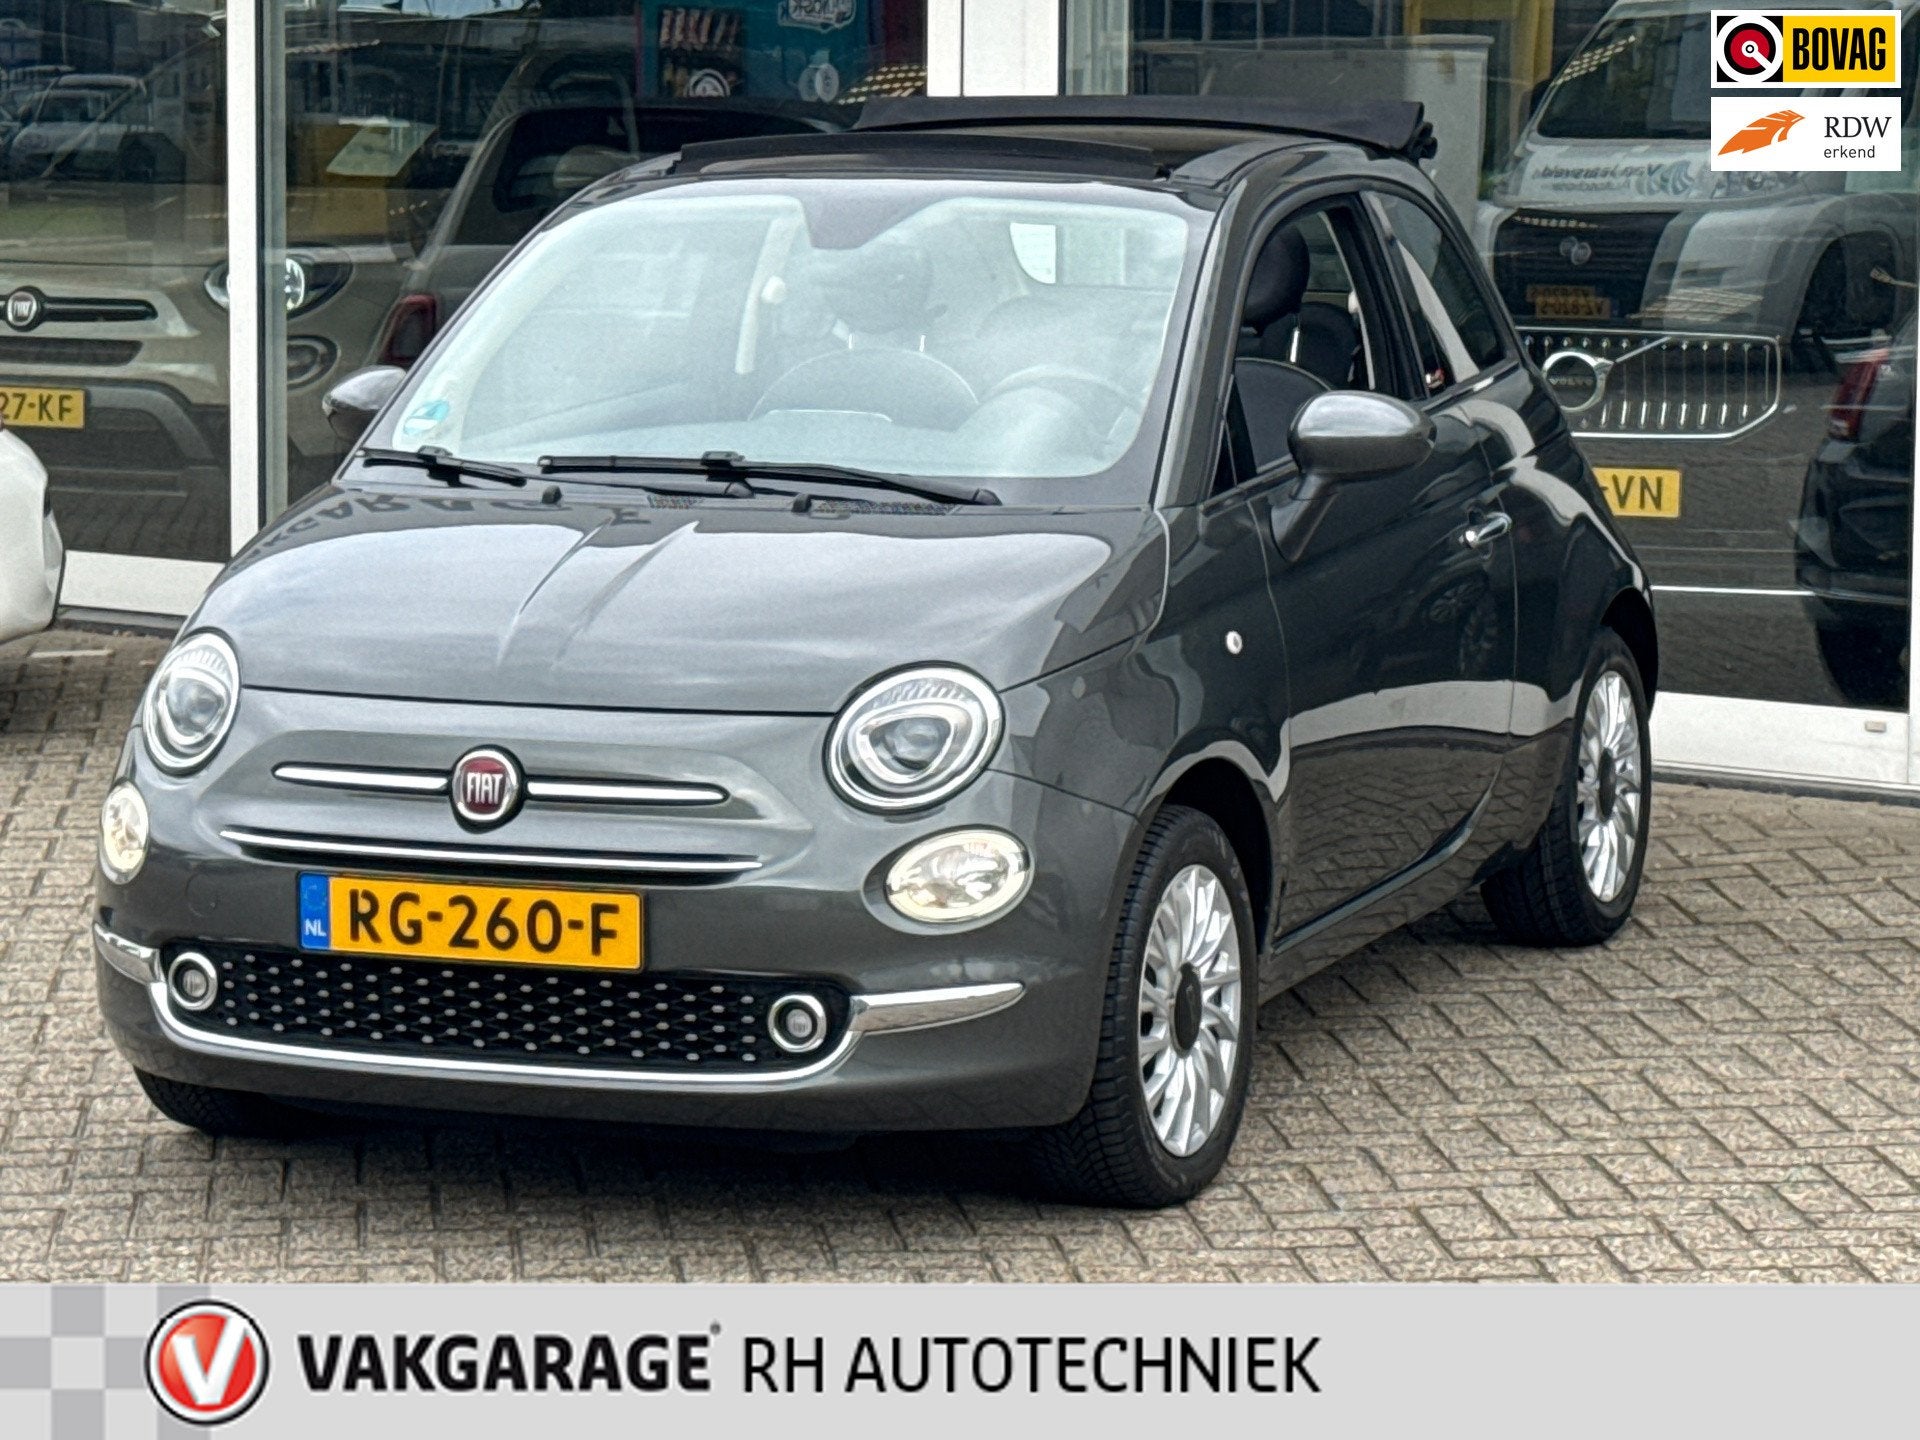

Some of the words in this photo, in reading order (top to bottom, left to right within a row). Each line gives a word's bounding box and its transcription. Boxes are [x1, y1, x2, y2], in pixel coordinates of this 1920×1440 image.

[466, 772, 503, 804] FIAT
[305, 918, 326, 937] NL
[349, 888, 621, 956] RG-260-F
